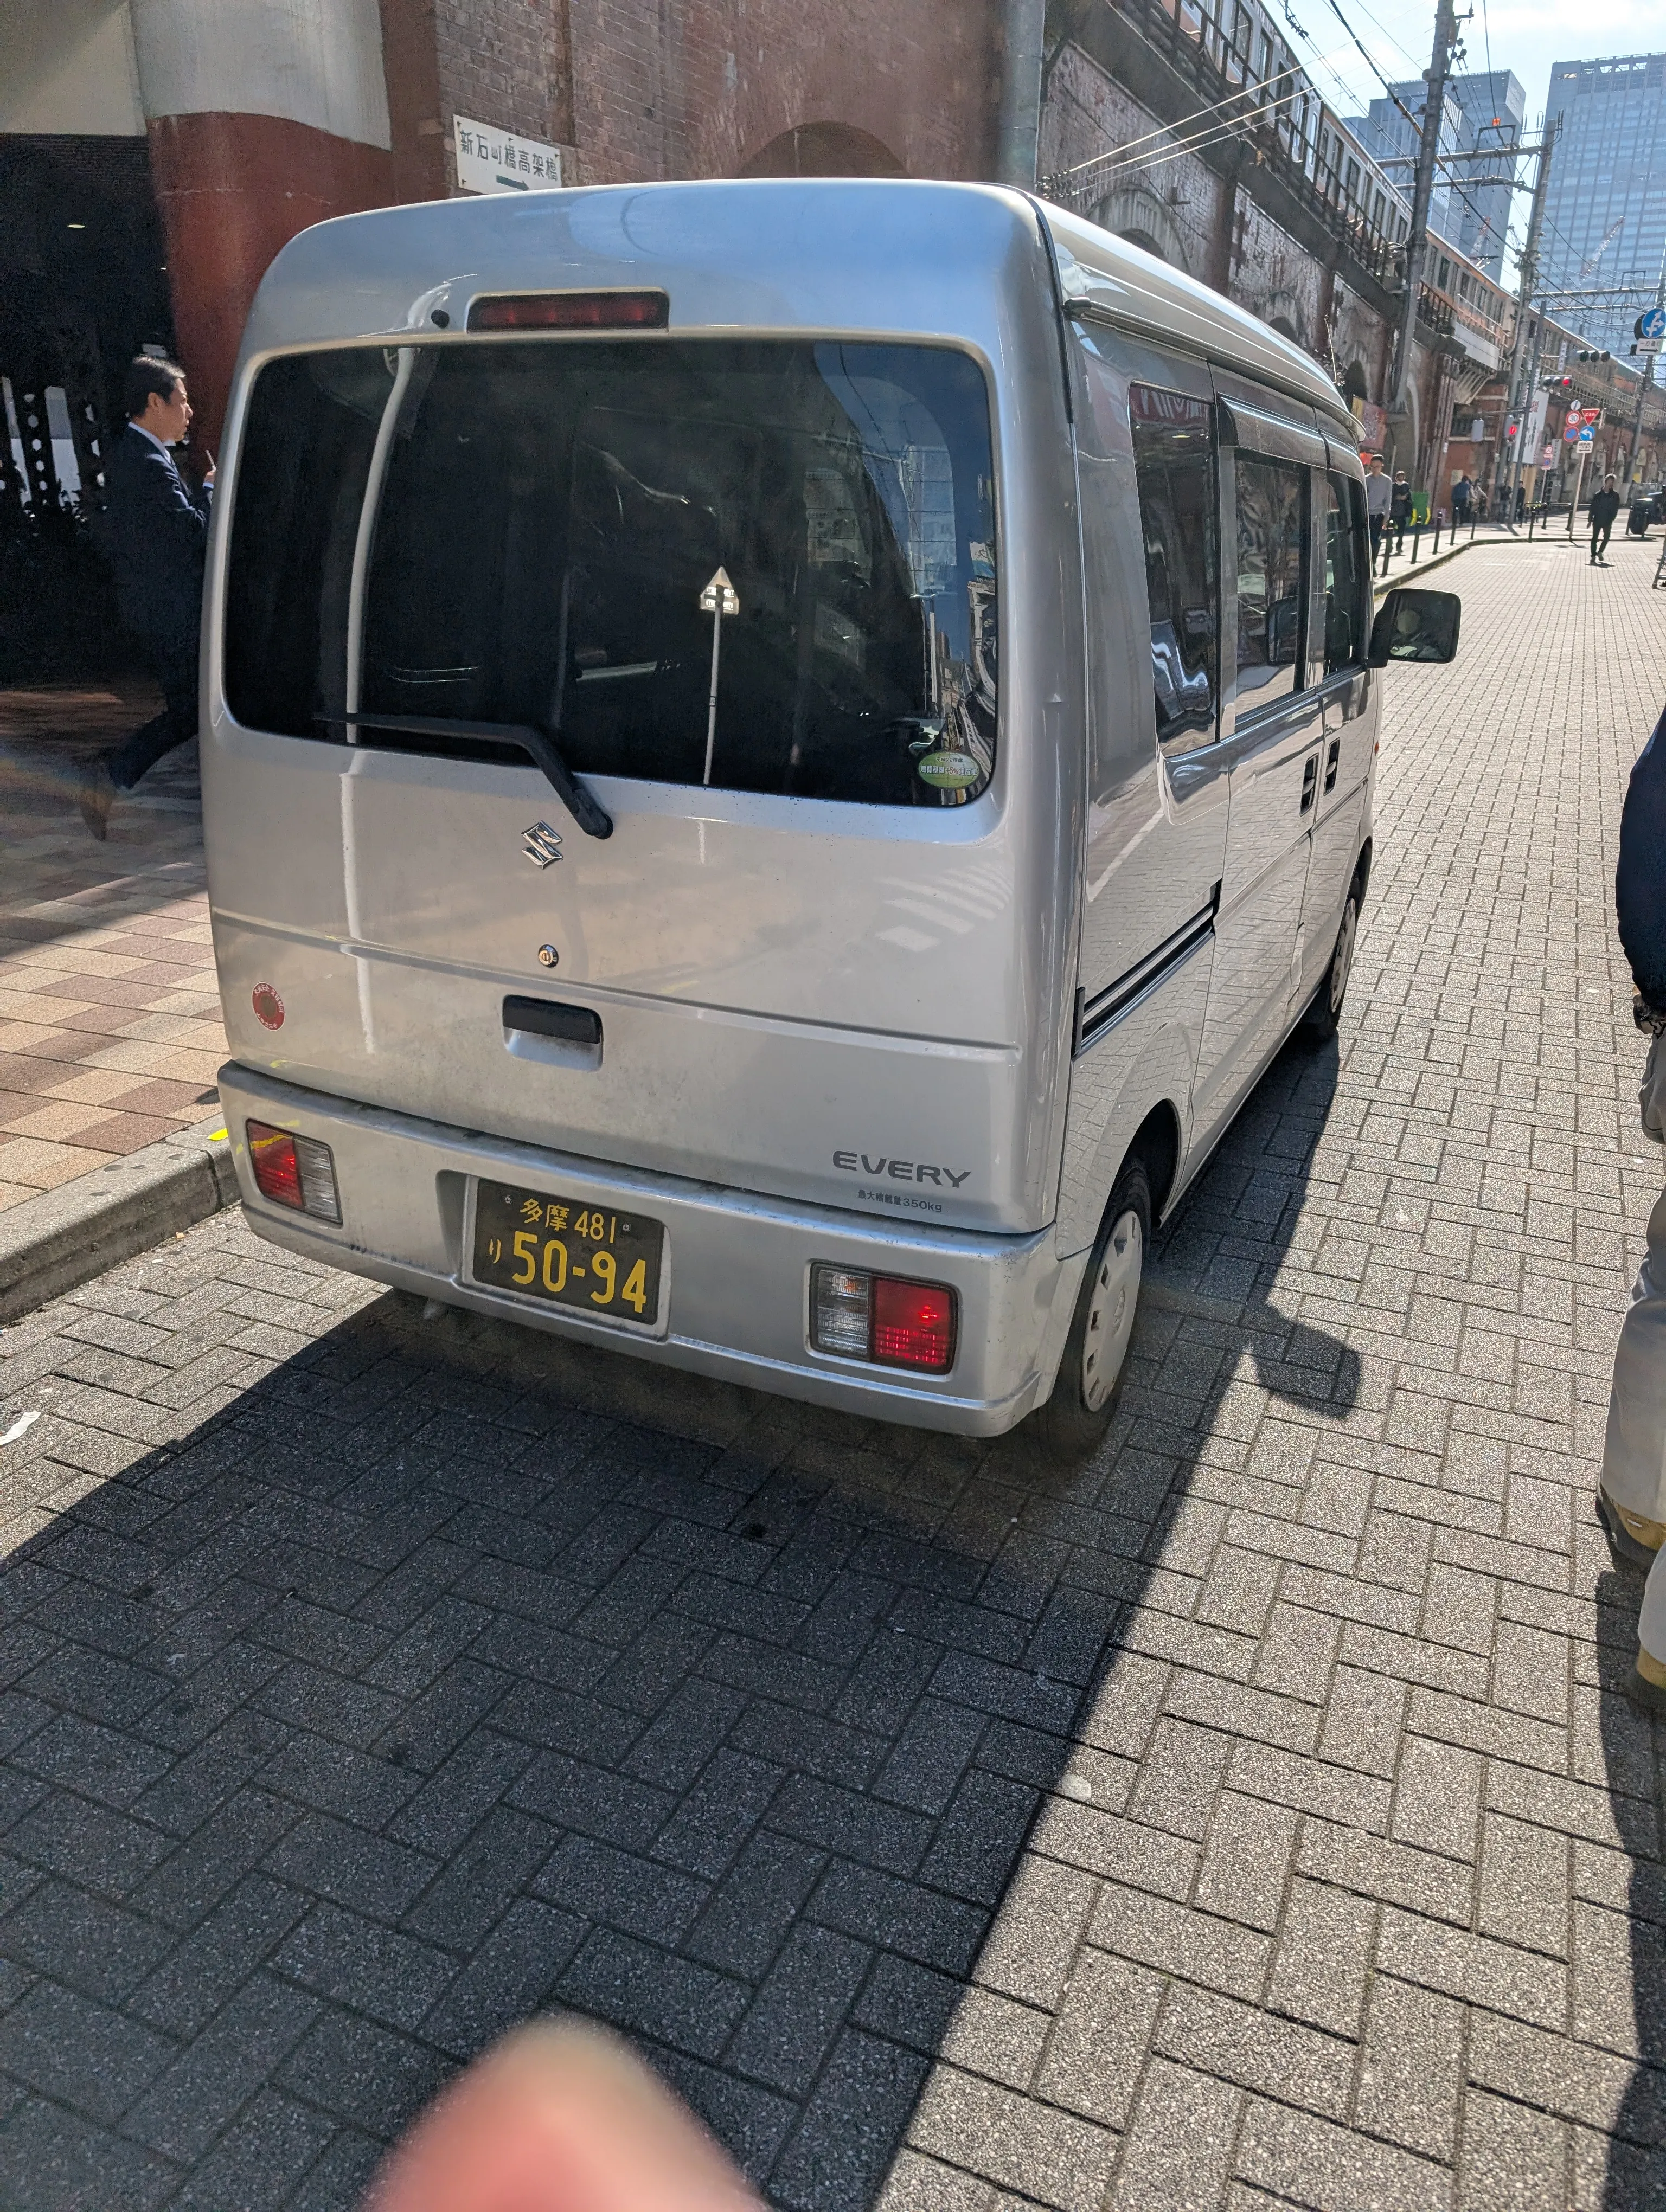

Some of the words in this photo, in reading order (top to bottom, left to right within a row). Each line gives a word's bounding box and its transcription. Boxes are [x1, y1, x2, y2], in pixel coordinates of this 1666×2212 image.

[832, 1150, 971, 1188] EVERY
[520, 1198, 570, 1231] 多摩
[574, 1210, 616, 1244] 481
[858, 1189, 942, 1213] 最大積載量350kg
[489, 1238, 502, 1264] り
[511, 1230, 647, 1313] 50-94
